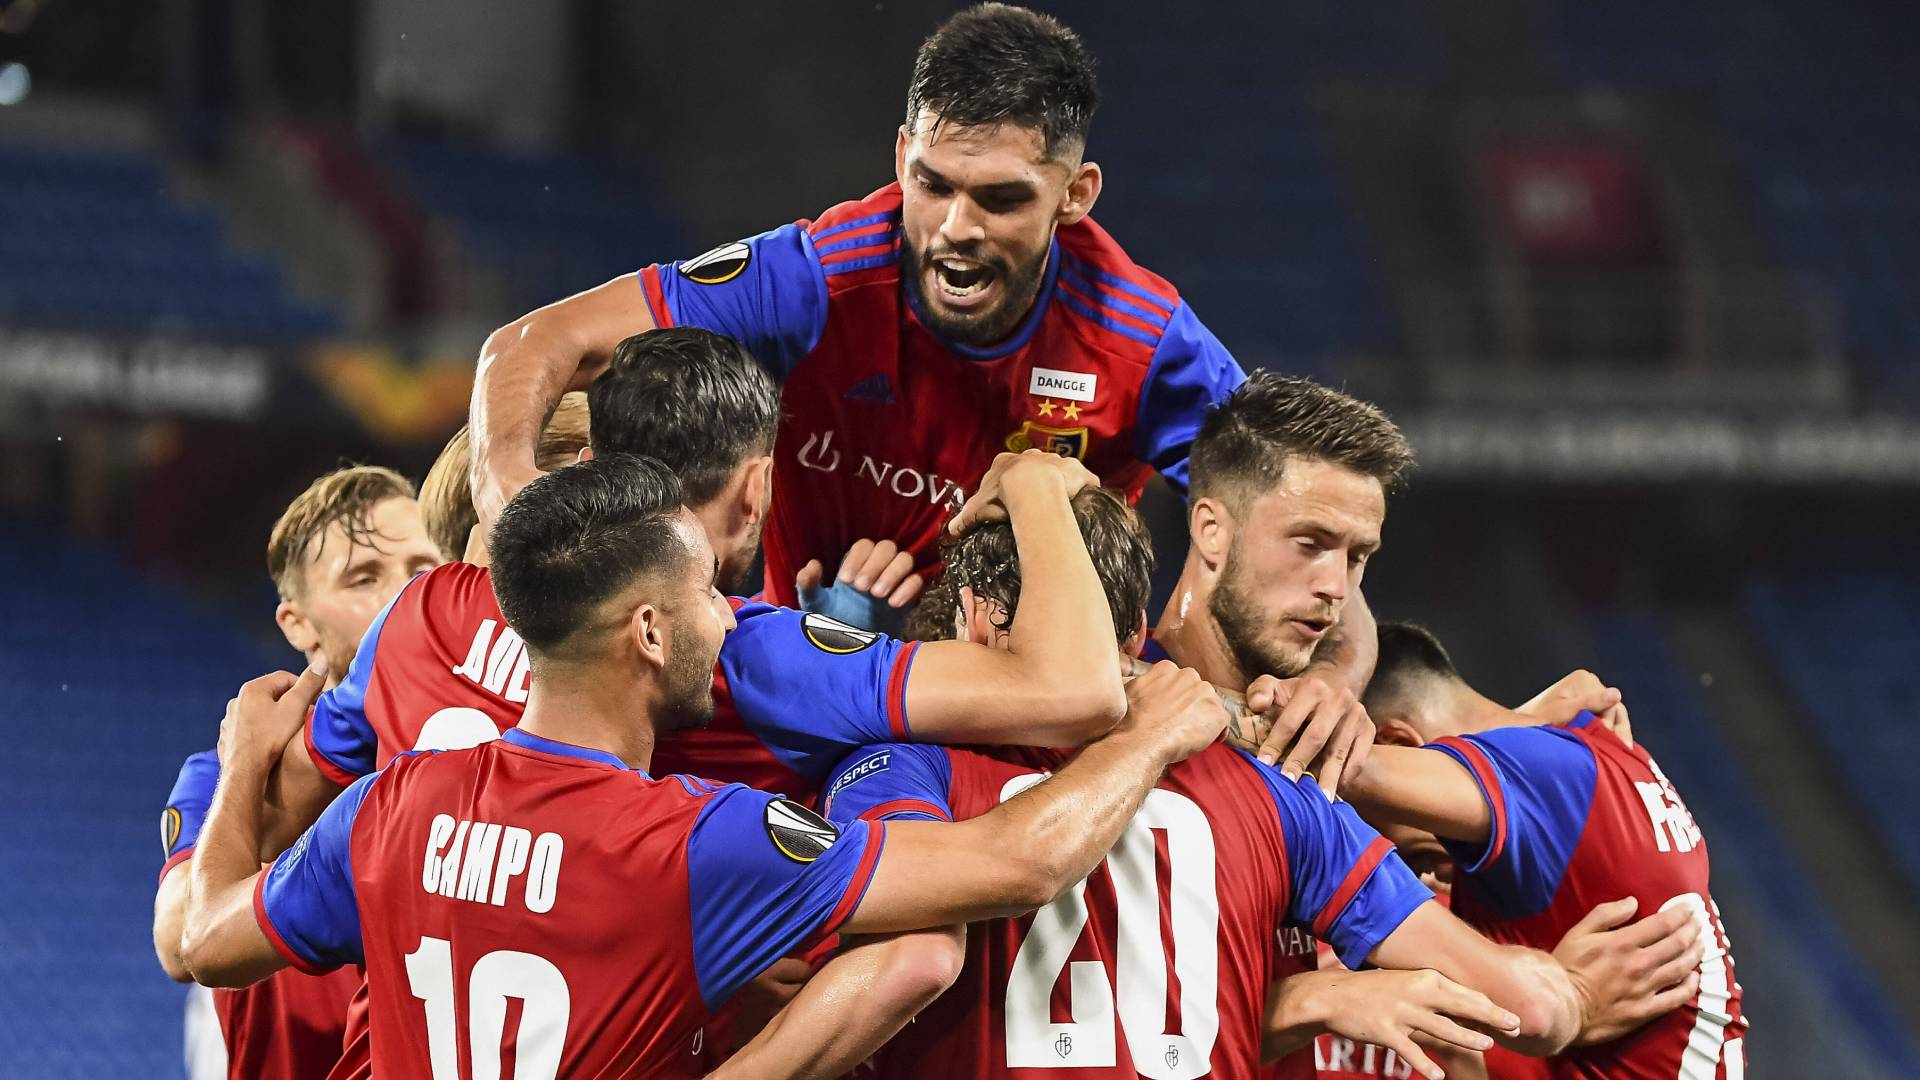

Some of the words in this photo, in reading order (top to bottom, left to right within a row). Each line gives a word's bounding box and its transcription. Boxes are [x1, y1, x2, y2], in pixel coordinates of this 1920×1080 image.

[1037, 376, 1087, 392] DANGGE
[422, 813, 565, 914] CAMPO
[1000, 772, 1220, 1080] 20
